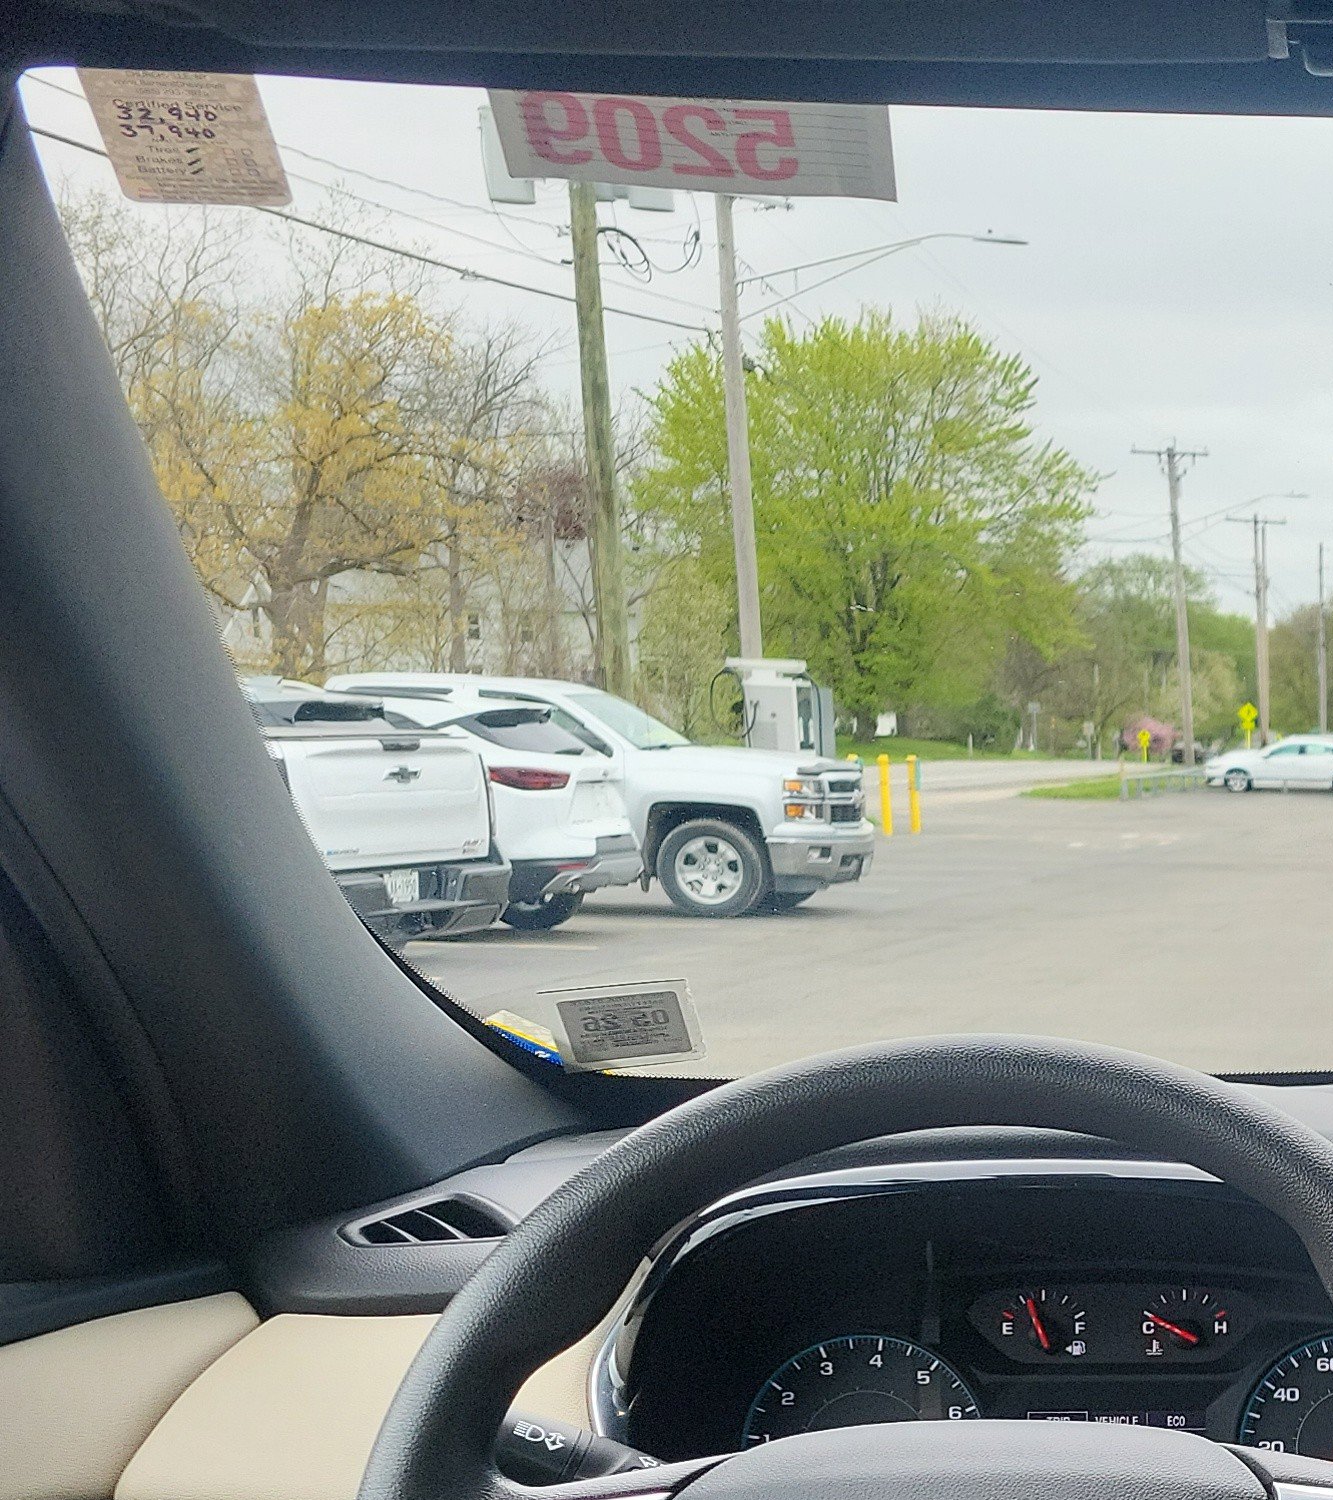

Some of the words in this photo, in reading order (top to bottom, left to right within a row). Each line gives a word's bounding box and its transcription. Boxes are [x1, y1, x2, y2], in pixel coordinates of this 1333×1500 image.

[185, 101, 243, 112] Service
[1002, 1322, 1014, 1335] E
[1075, 1322, 1086, 1335] F
[1142, 1322, 1155, 1335] C
[1215, 1322, 1227, 1335] H
[869, 1354, 883, 1368] 4
[820, 1362, 833, 1375] 3
[917, 1371, 931, 1385] 5
[781, 1392, 795, 1406] 2
[1273, 1388, 1300, 1401] 40
[949, 1406, 962, 1420] 6
[1095, 1415, 1139, 1426] VEHICLE
[1167, 1415, 1186, 1427] ECO
[1258, 1441, 1284, 1453] 20
